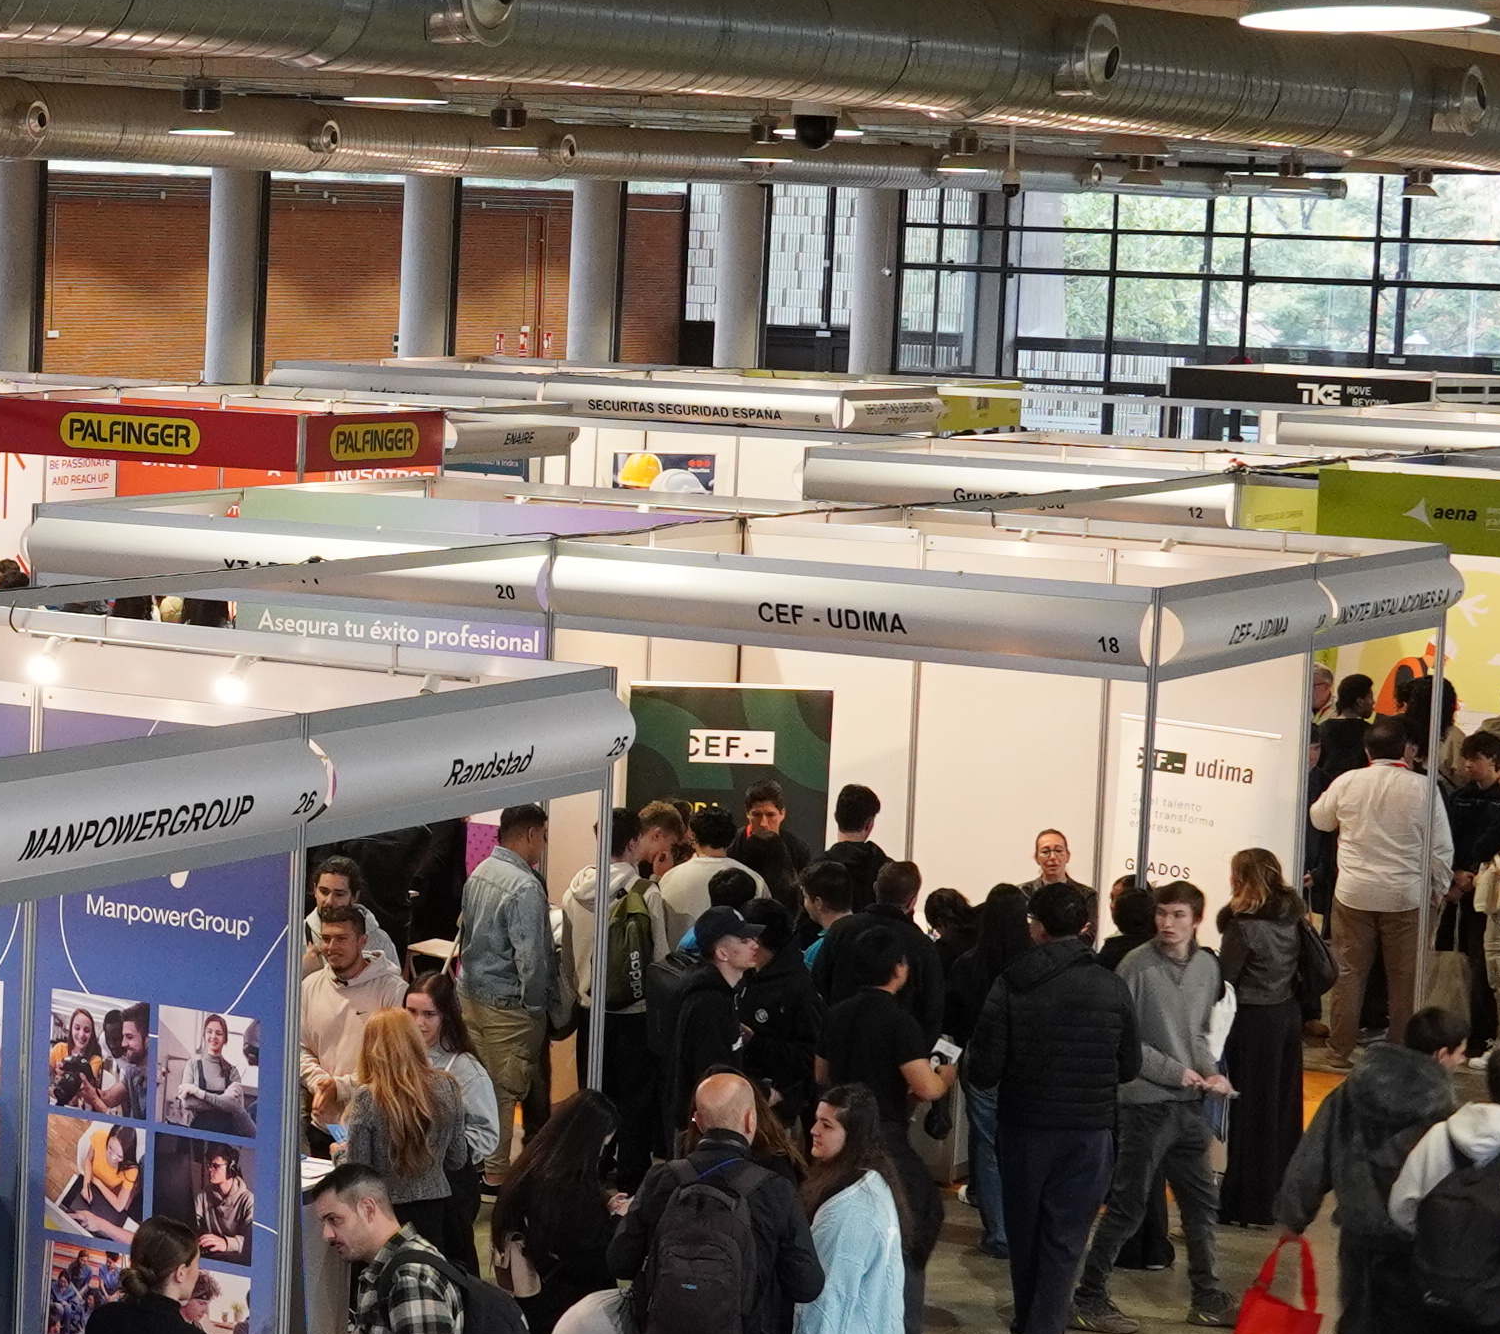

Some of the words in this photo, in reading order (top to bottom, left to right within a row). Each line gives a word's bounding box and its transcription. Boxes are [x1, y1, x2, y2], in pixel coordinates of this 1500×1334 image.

[1297, 383, 1341, 405] TKE
[1347, 385, 1371, 396] MOVE
[588, 399, 655, 414] SECURITAS
[658, 403, 729, 418] SEGURIDAD
[732, 406, 782, 421] ESPAÑA
[814, 415, 821, 423] 6
[69, 417, 191, 449] PALFINGER
[335, 426, 415, 454] PALFINGER
[49, 460, 59, 470] BE
[52, 475, 69, 486] AND
[71, 474, 96, 485] REACH
[98, 473, 109, 483] UP
[1188, 507, 1203, 519] 12
[1433, 507, 1477, 522] aena
[495, 584, 515, 600] 20
[257, 608, 339, 638] Asegura
[345, 620, 364, 638] tu
[370, 617, 420, 644] éxito
[425, 624, 540, 654] profesional
[758, 602, 805, 624] CEF
[827, 607, 908, 635] UDIMA
[1097, 636, 1121, 654] 18
[1229, 624, 1253, 645] CEF
[1255, 617, 1289, 641] UDIMA
[443, 745, 535, 788] Randstad
[607, 735, 629, 758] 25
[1195, 759, 1254, 785] udima
[1163, 798, 1202, 812] talento
[17, 794, 255, 861] MANPOWERGROUP
[292, 791, 317, 815] 26
[1155, 810, 1215, 827] transforma
[1125, 858, 1191, 880] GADOS
[85, 893, 251, 940] ManpowerGroup
[629, 950, 643, 999] adidas
